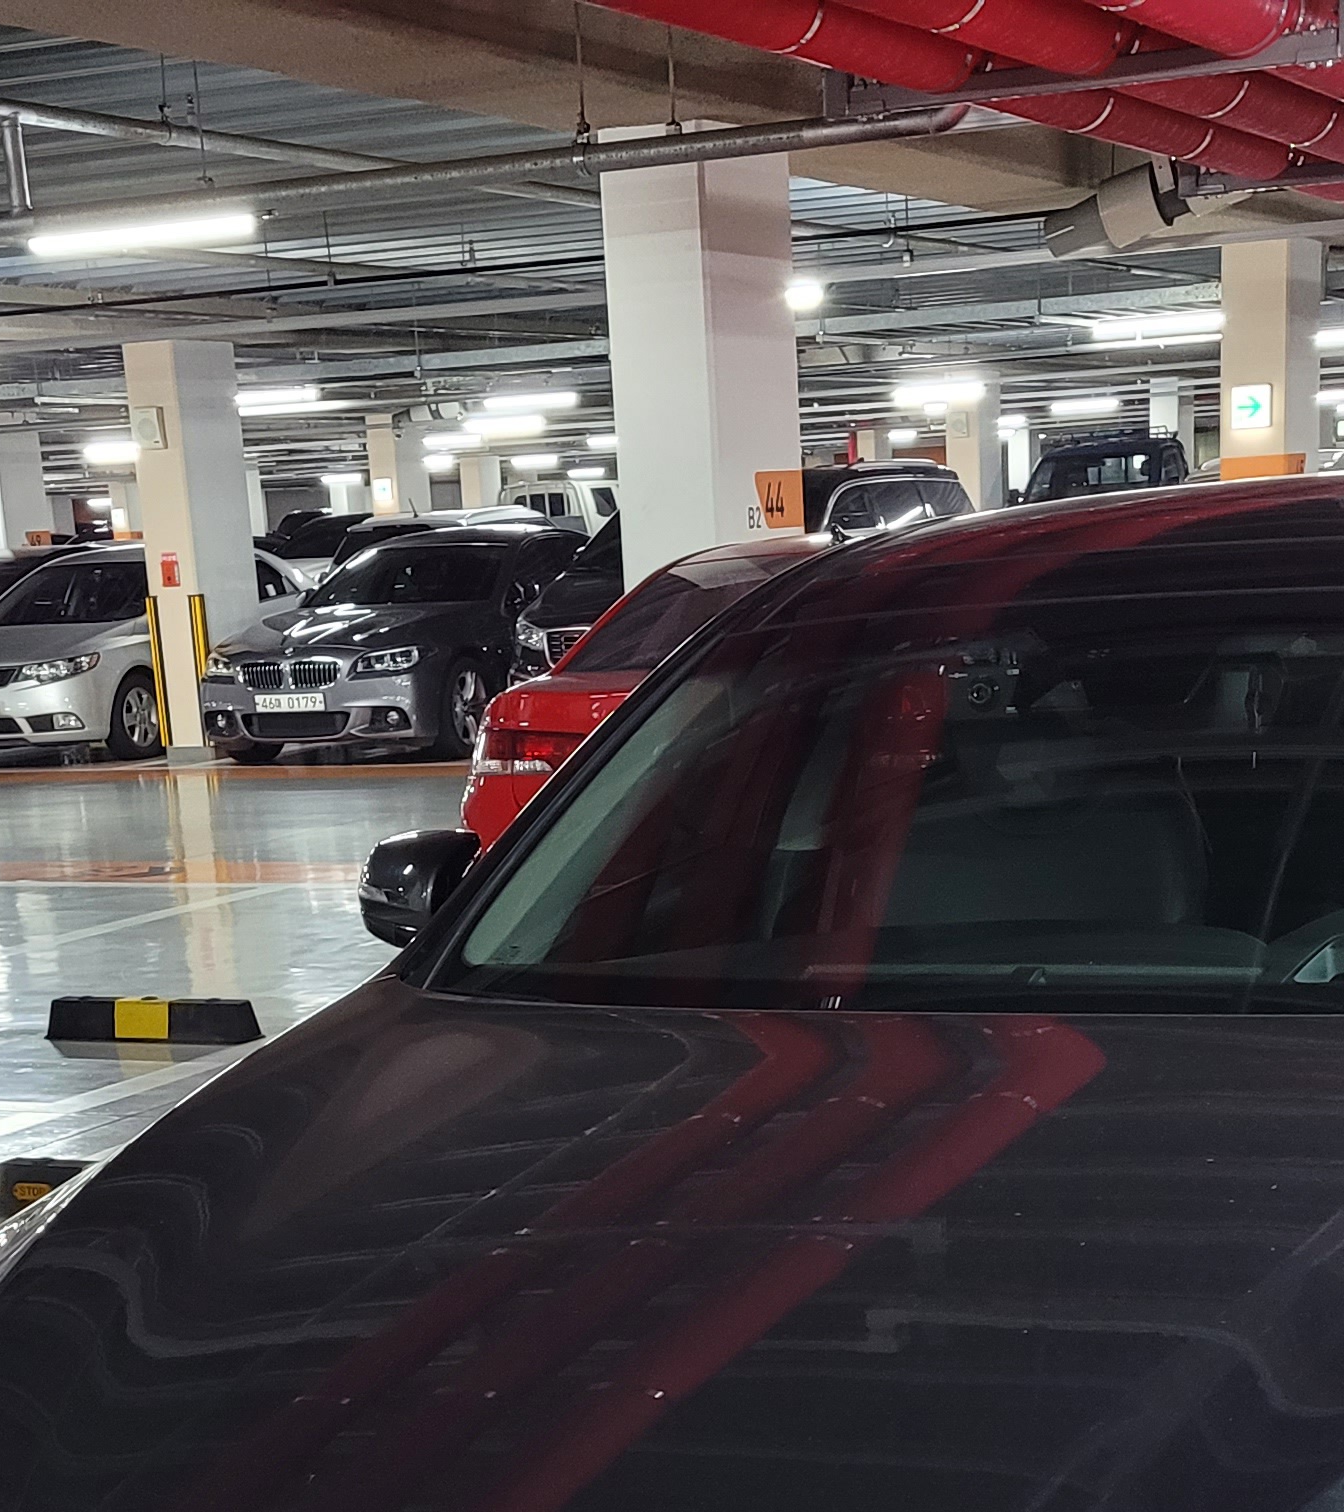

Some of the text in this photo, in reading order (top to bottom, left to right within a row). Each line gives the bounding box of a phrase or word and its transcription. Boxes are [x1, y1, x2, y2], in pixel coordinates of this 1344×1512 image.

[748, 481, 784, 529] B2 44
[287, 696, 318, 709] 0179
